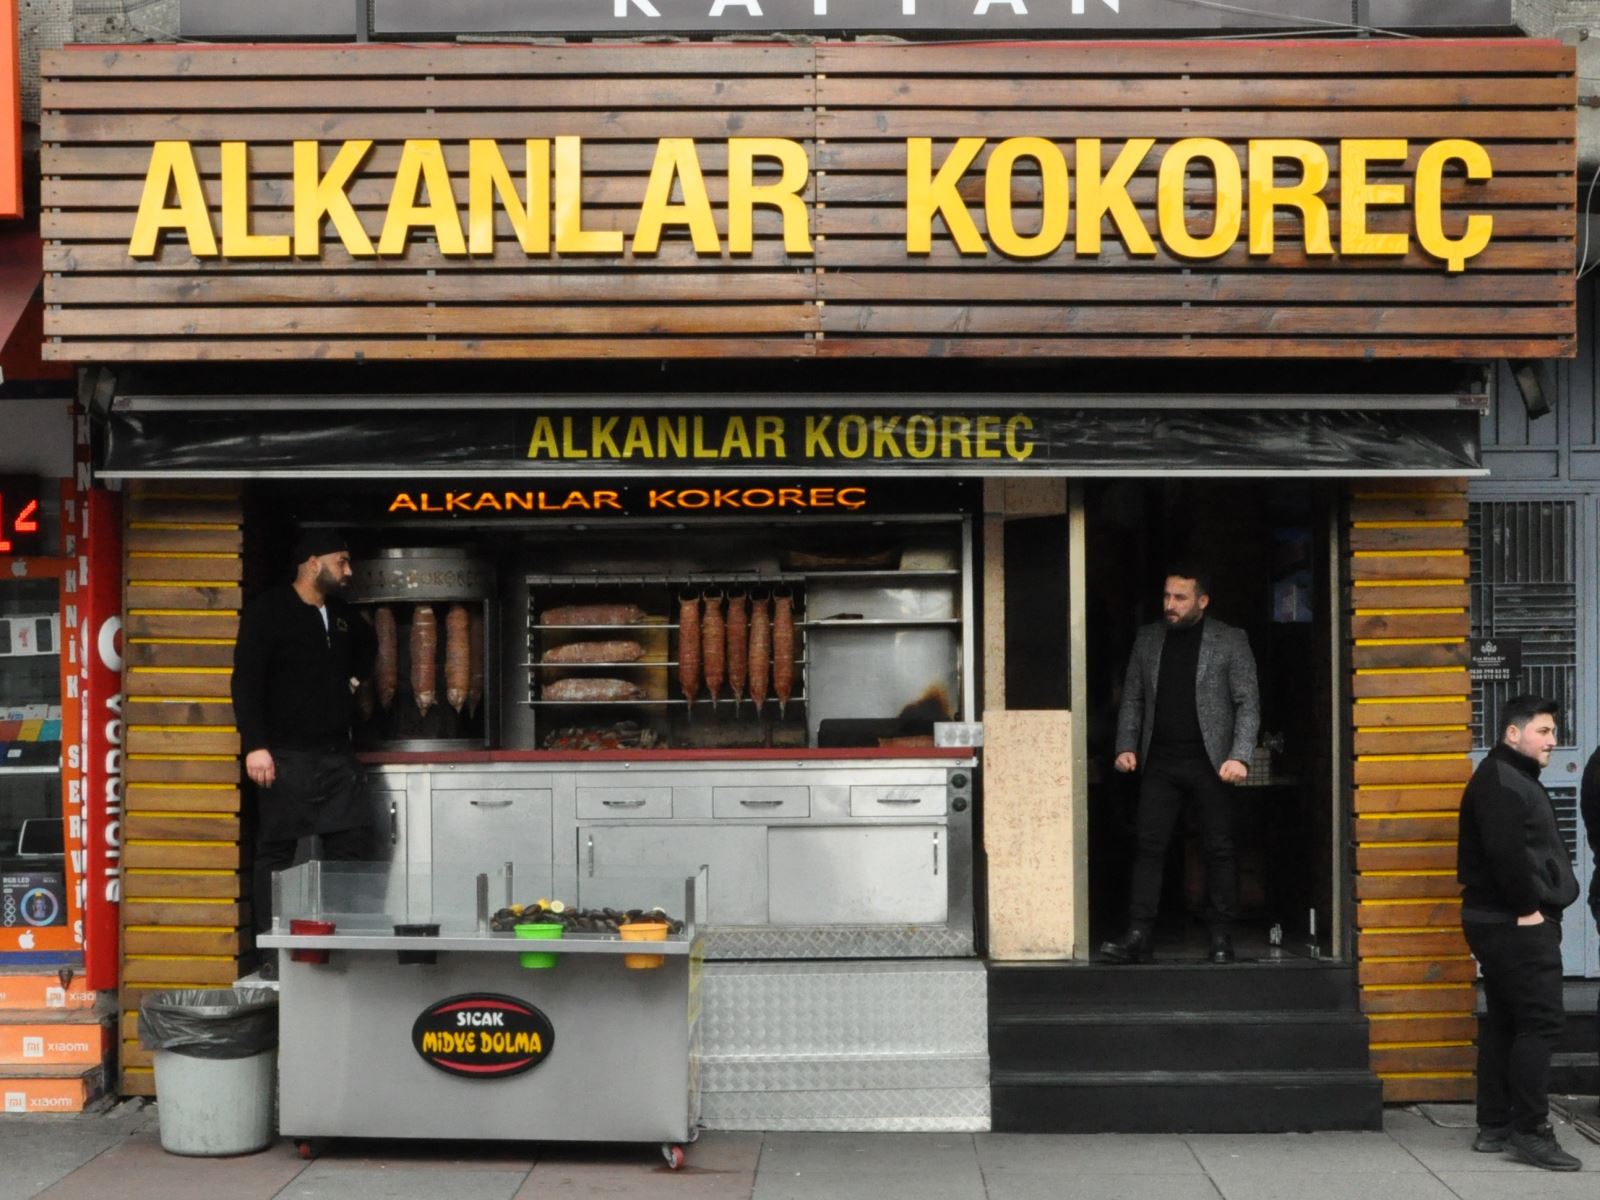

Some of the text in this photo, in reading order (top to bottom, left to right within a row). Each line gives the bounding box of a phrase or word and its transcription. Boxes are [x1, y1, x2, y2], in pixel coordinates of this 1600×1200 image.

[128, 135, 1494, 273] ALKANLAR KOKOREÇ
[527, 415, 1035, 462] ALKANLAR KOKOREÇ
[387, 487, 867, 512] ALKANLAR KOKOREÇ
[456, 1011, 504, 1026] SICAK
[480, 1031, 542, 1054] DOLMA
